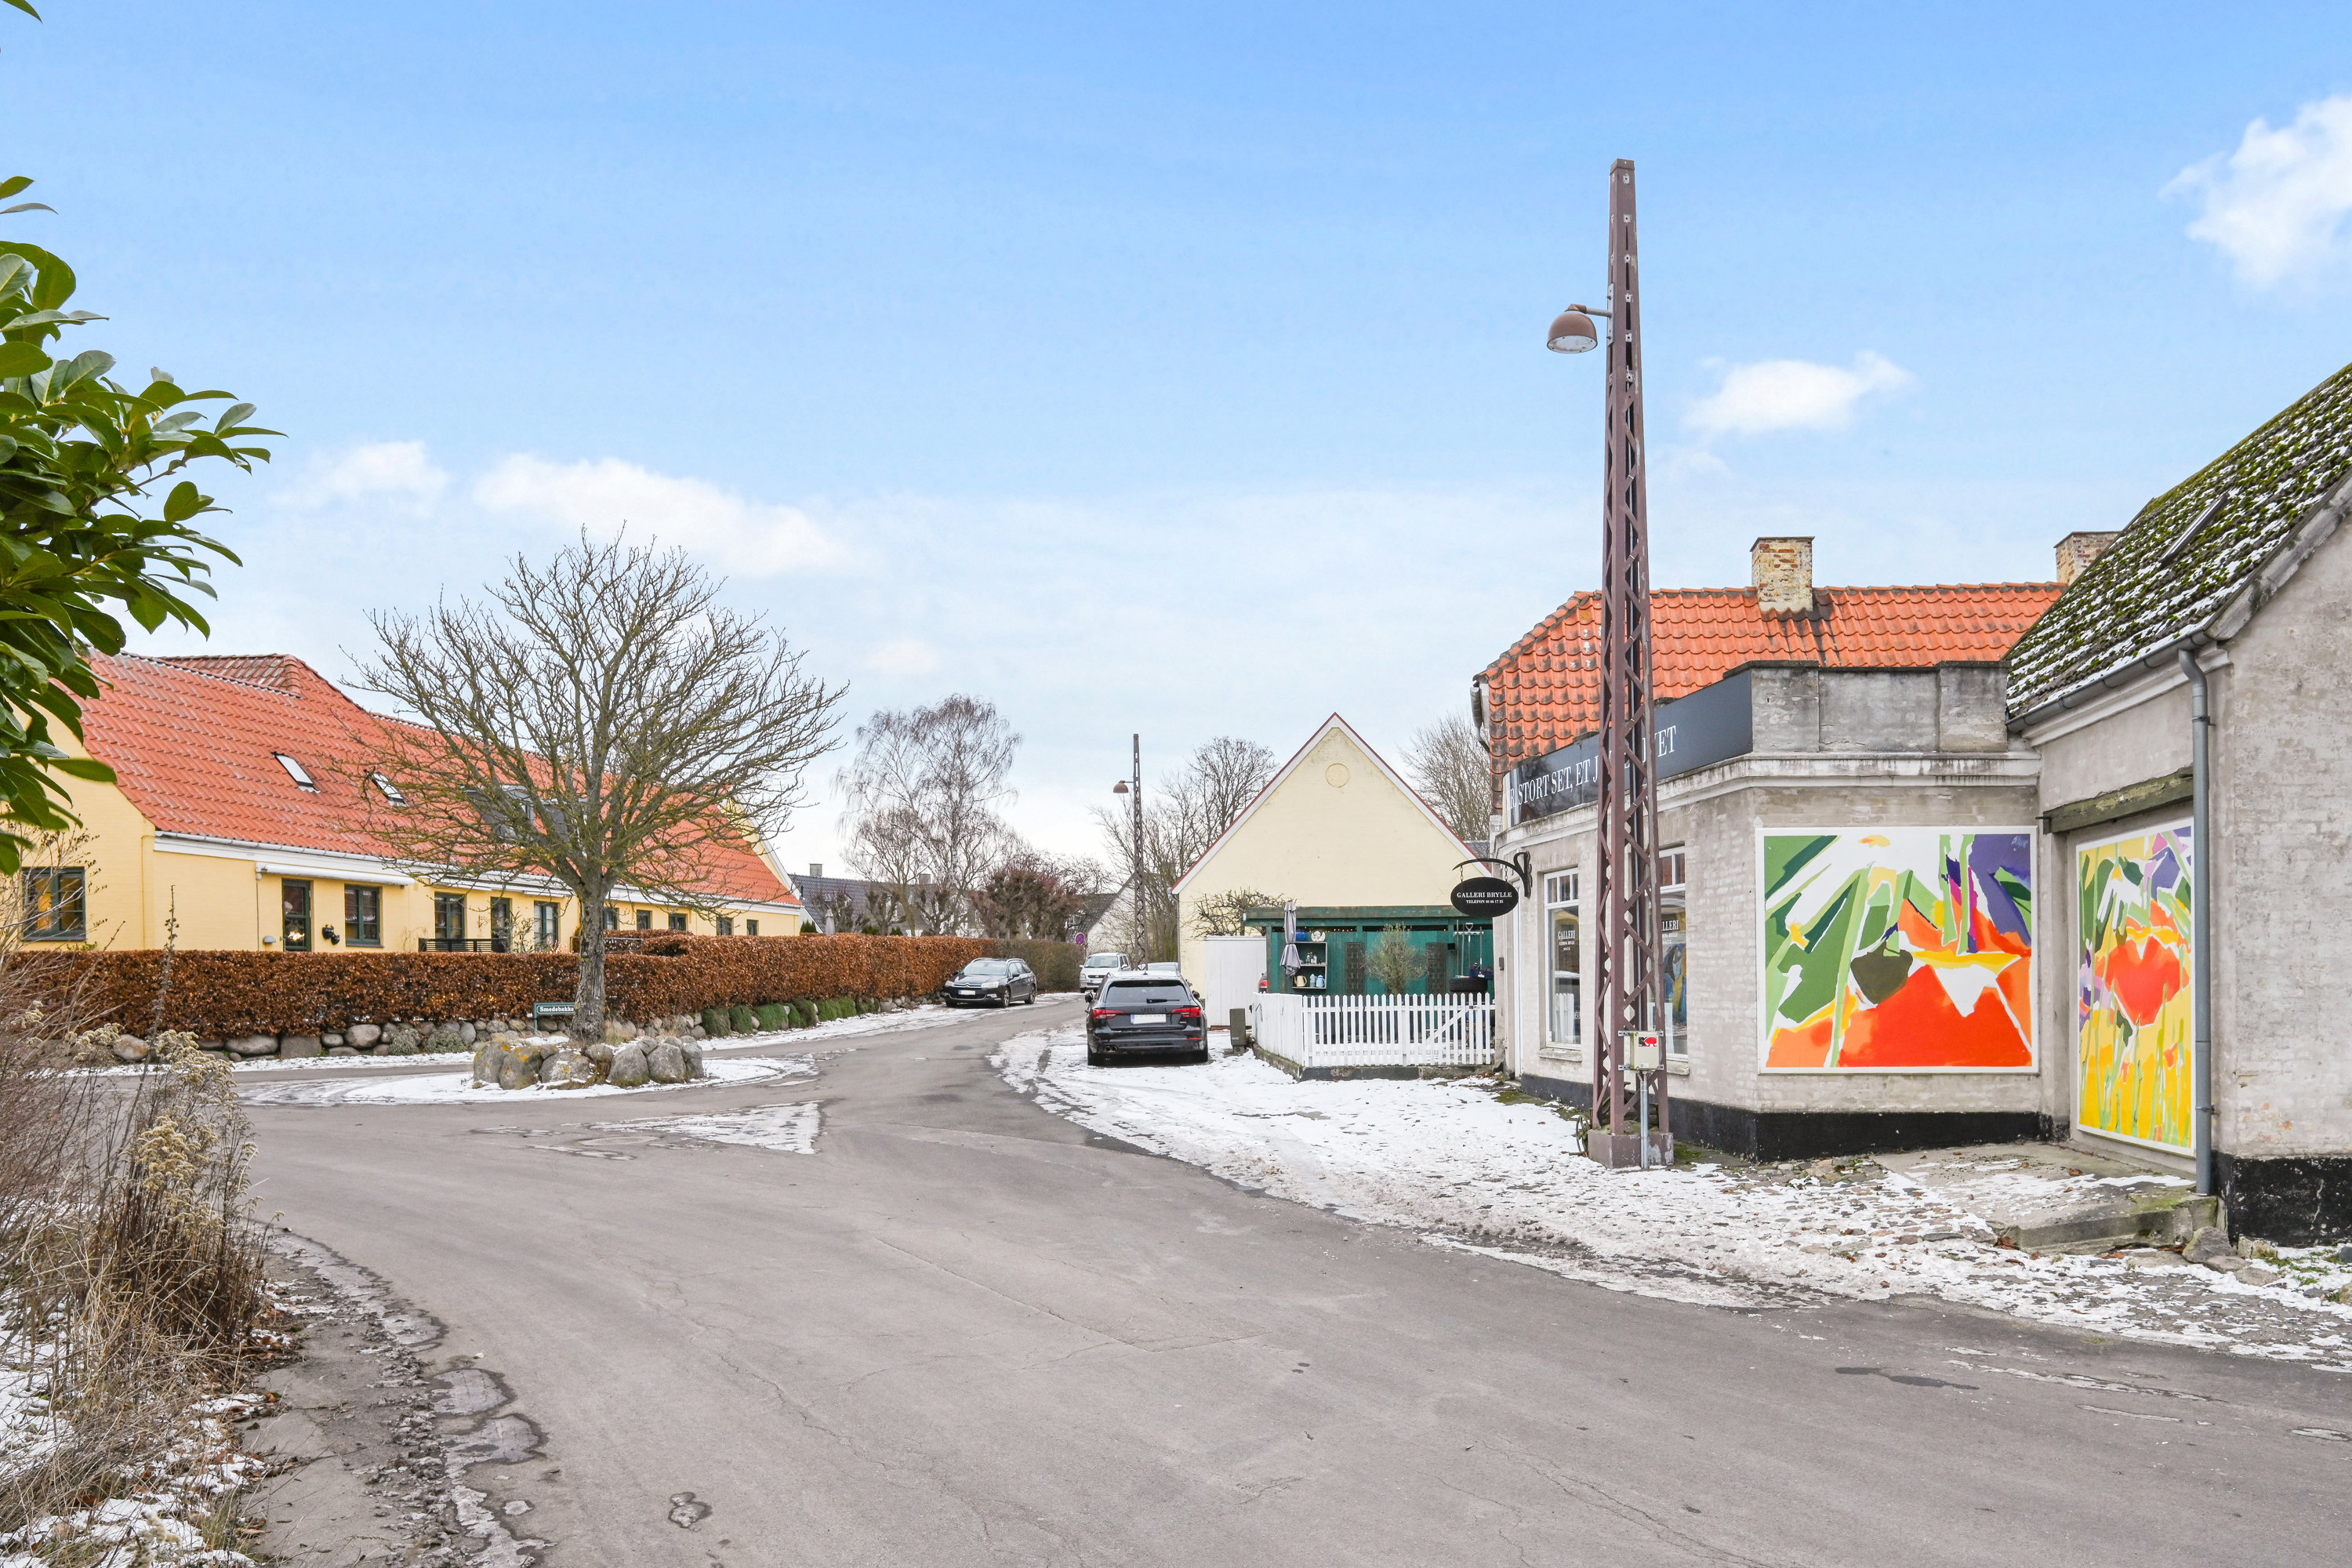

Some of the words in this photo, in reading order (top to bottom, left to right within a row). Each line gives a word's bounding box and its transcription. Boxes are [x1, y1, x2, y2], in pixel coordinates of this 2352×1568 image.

[1518, 774, 1550, 805] STORT
[1552, 766, 1573, 793] SET,
[1576, 759, 1591, 786] ET
[1662, 920, 1679, 931] LLERI
